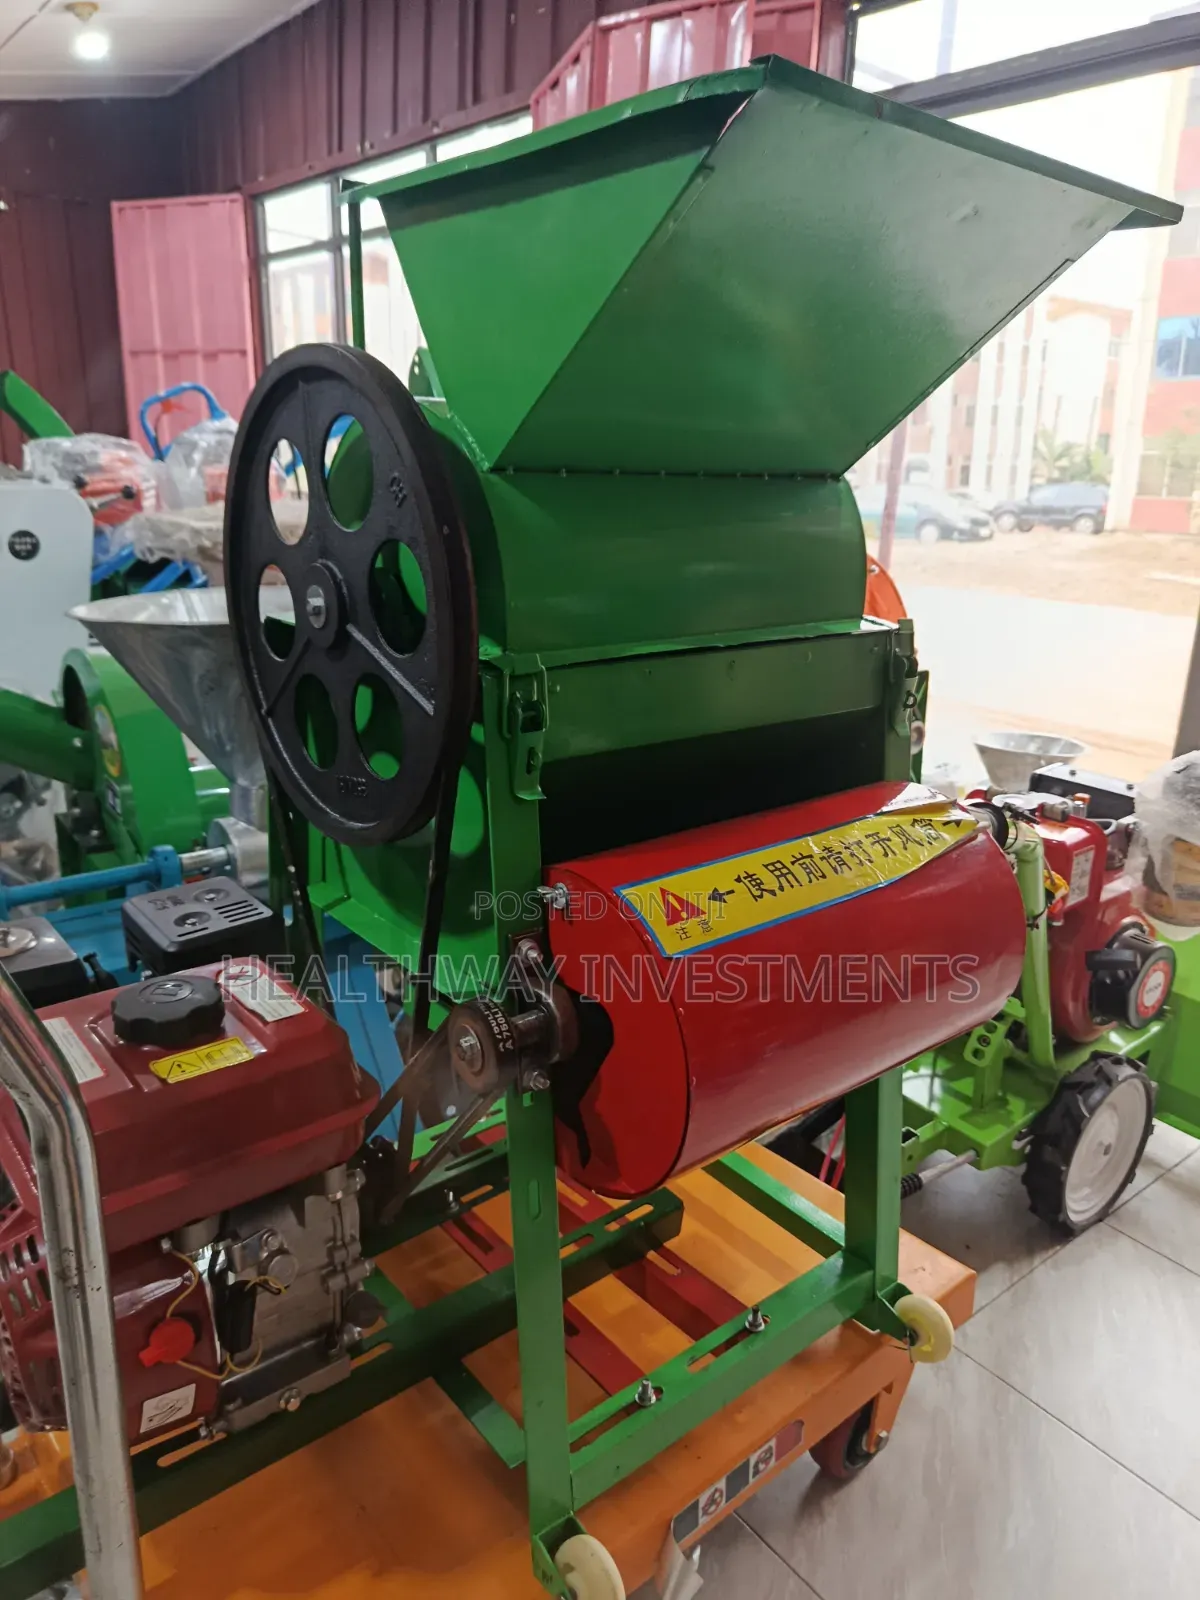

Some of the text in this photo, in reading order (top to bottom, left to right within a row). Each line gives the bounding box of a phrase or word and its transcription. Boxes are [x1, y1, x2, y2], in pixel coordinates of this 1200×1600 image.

[734, 816, 944, 902] 使用前请打开风筒
[675, 918, 714, 941] 注意
